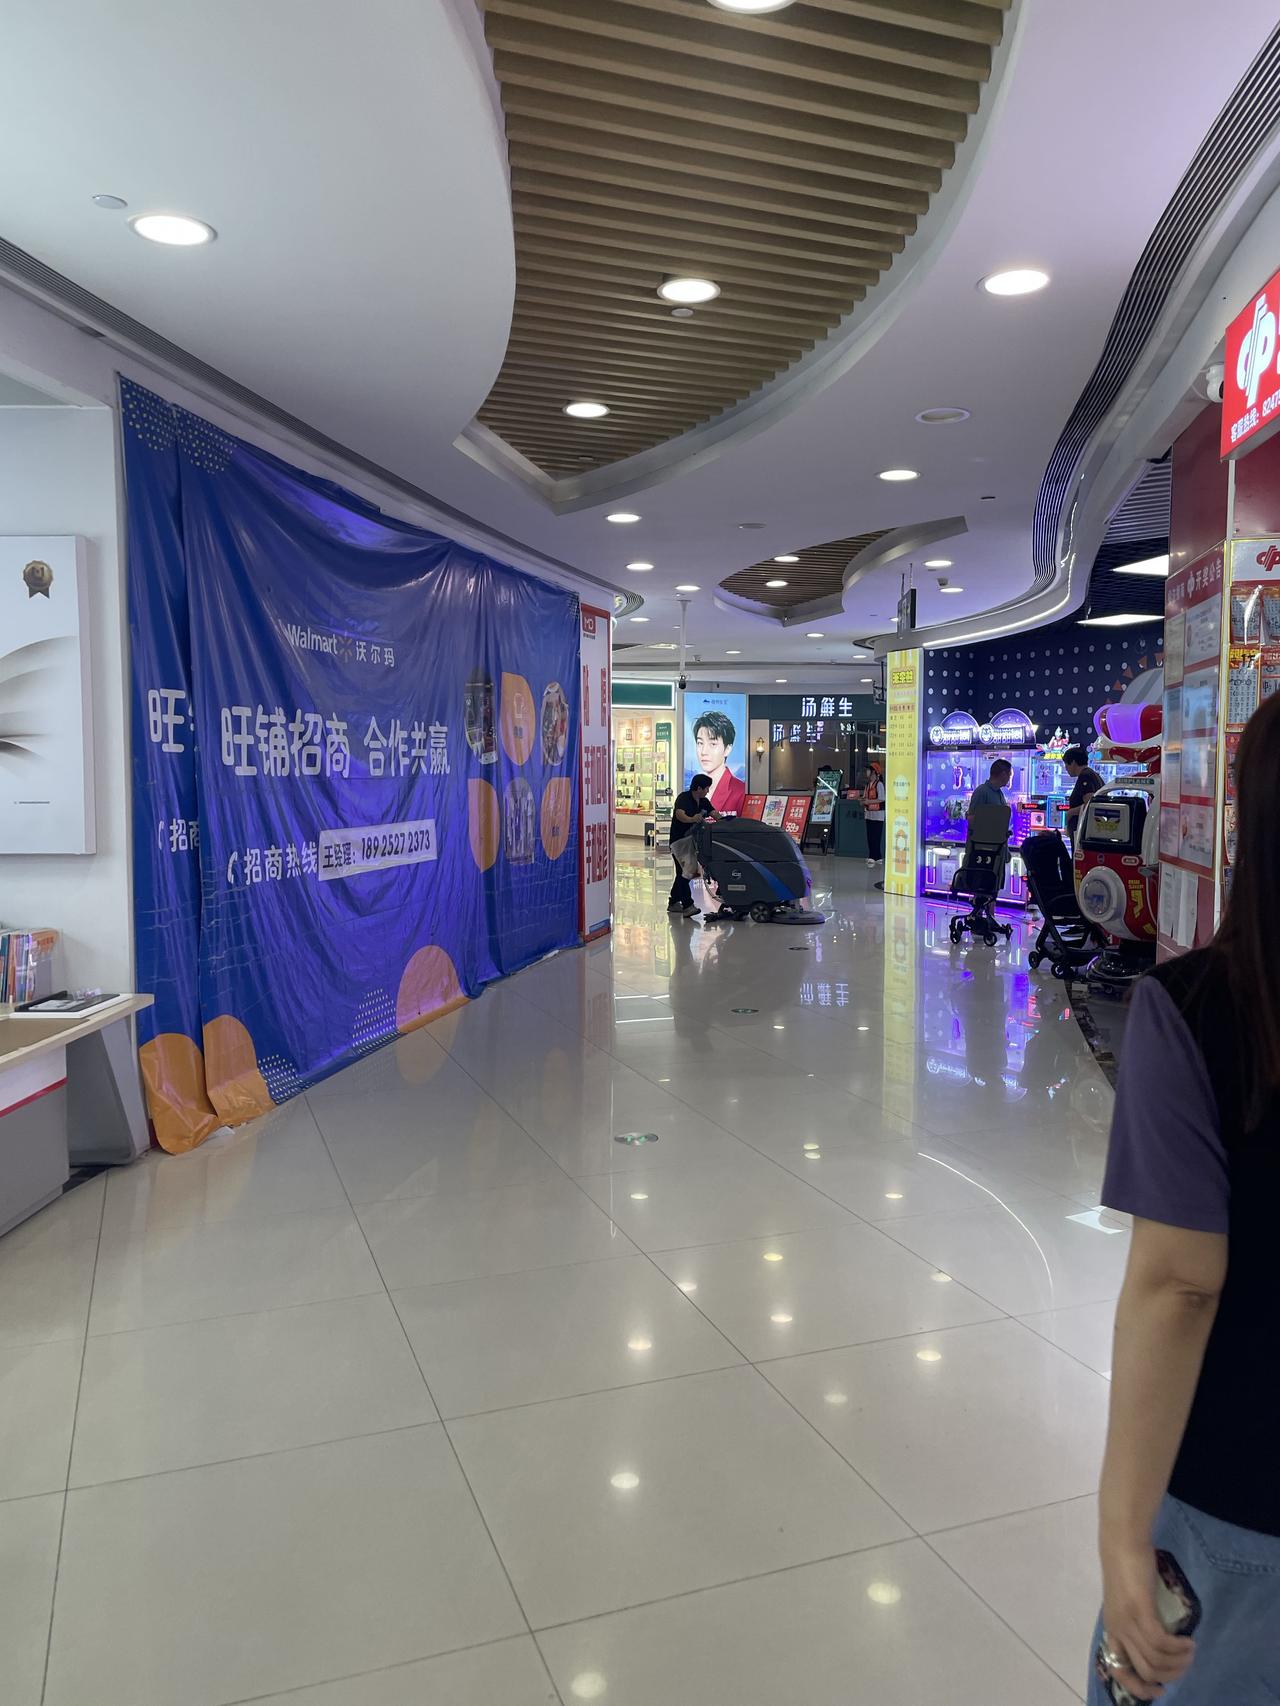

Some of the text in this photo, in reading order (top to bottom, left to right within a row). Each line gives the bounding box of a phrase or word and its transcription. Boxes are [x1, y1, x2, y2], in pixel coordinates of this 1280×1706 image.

[1195, 558, 1222, 591] 开奖公告
[286, 623, 395, 668] Walmart 沃尔玛
[801, 697, 853, 718] 汤鲜生
[221, 703, 451, 779] 旺铺招商 合作共赢
[408, 829, 431, 854] 2373
[243, 842, 318, 886] 招商热线
